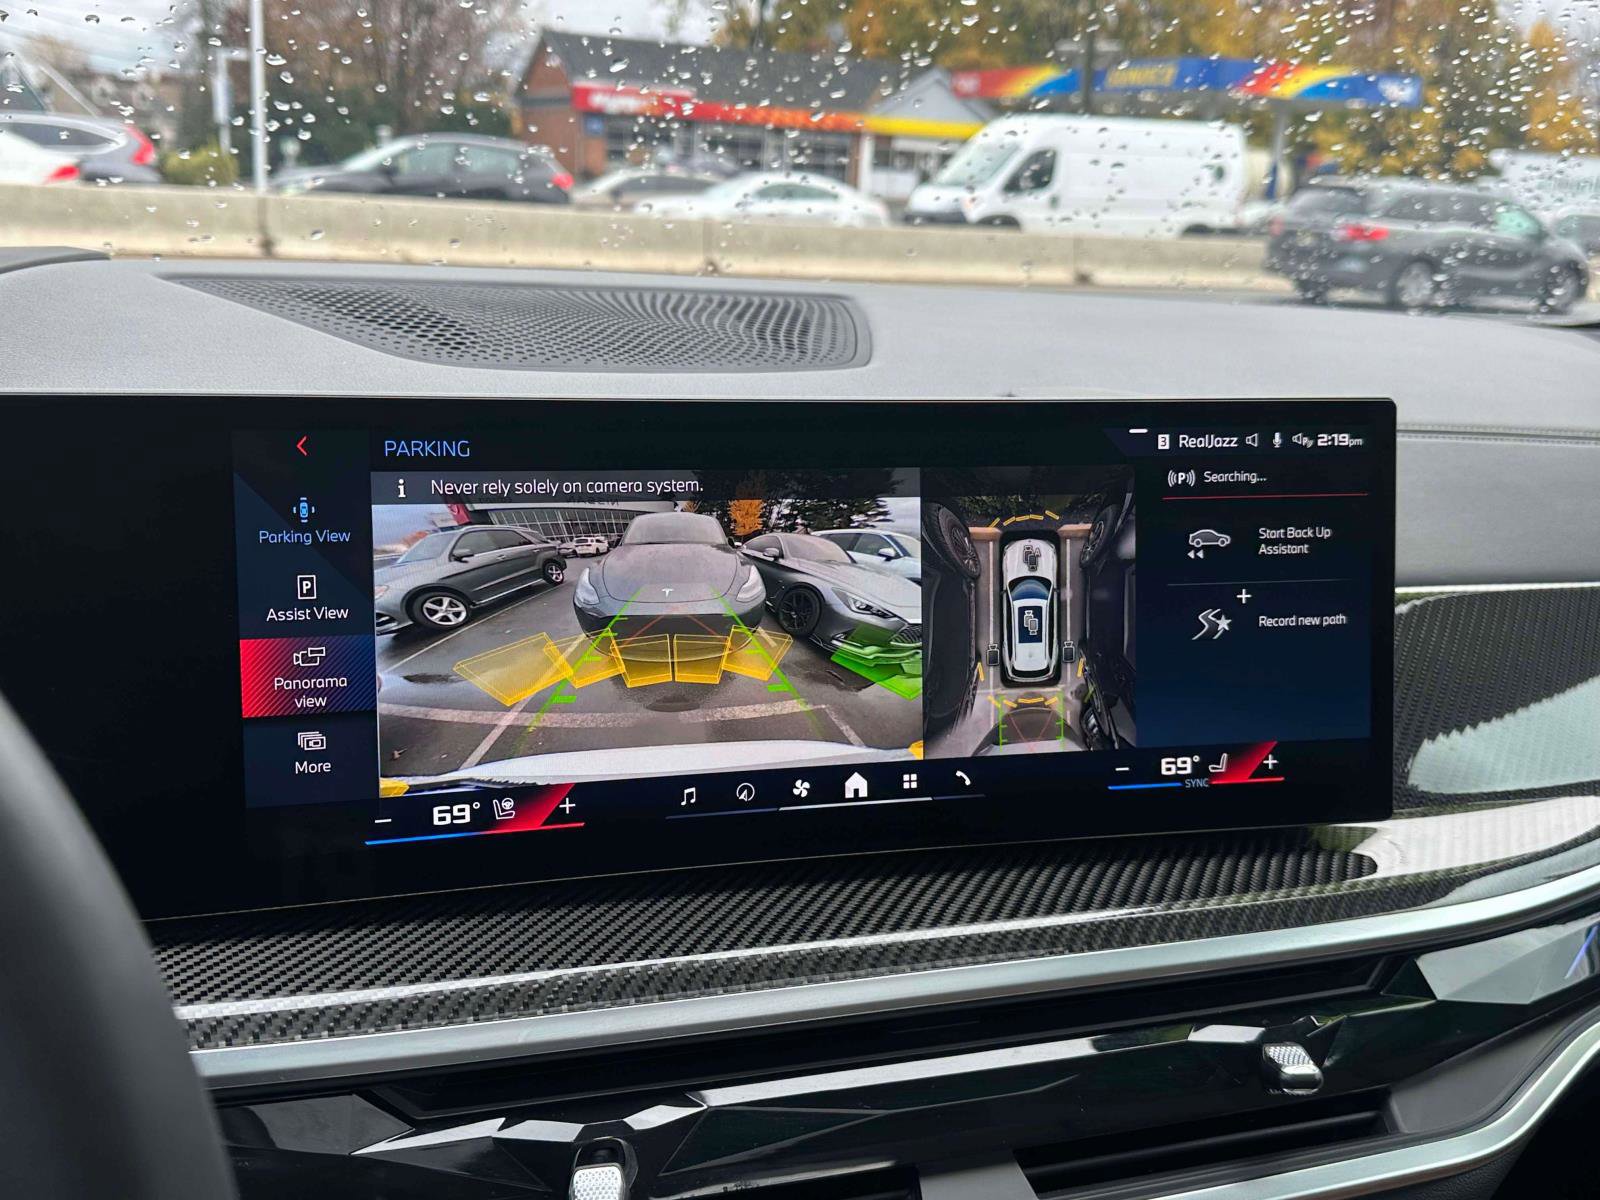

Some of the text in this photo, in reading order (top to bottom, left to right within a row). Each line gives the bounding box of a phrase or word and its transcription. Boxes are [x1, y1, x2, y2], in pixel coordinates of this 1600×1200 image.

[1178, 434, 1238, 448] RealJazz
[1317, 433, 1363, 447] 2:19pm
[384, 440, 470, 457] PARKING
[430, 478, 704, 497] Never rely solely on camera system.
[259, 529, 351, 547] Parking View
[1258, 526, 1332, 540] Start Back Up
[1258, 543, 1309, 556] Assistant
[266, 606, 349, 622] Assist View
[1258, 613, 1347, 628] Record new path
[273, 675, 348, 691] Panorama
[294, 694, 328, 709] view
[295, 760, 332, 775] More
[1184, 778, 1210, 789] SYNC
